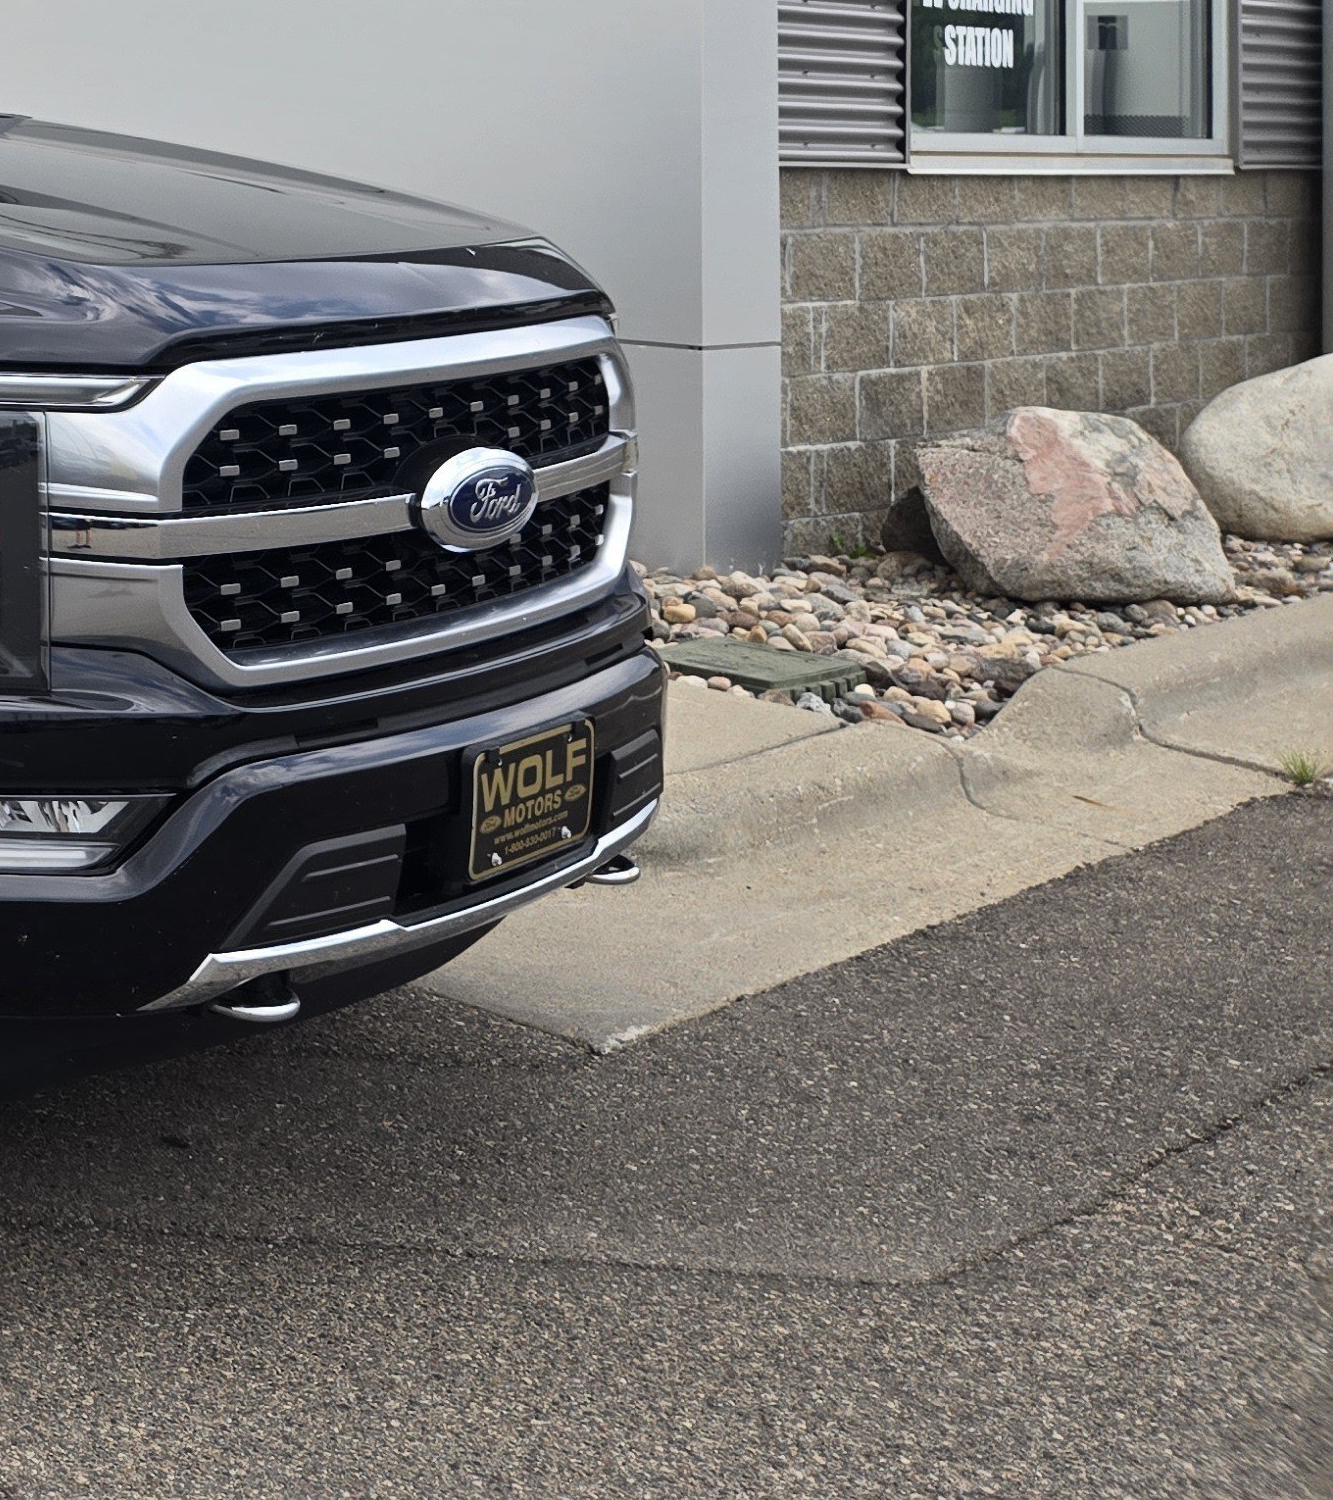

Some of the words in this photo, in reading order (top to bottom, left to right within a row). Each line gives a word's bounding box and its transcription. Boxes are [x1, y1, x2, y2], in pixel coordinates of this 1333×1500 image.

[944, 24, 1014, 68] STATION
[469, 476, 521, 523] Ford
[481, 738, 587, 813] WOLF
[502, 789, 562, 828] MOTORS
